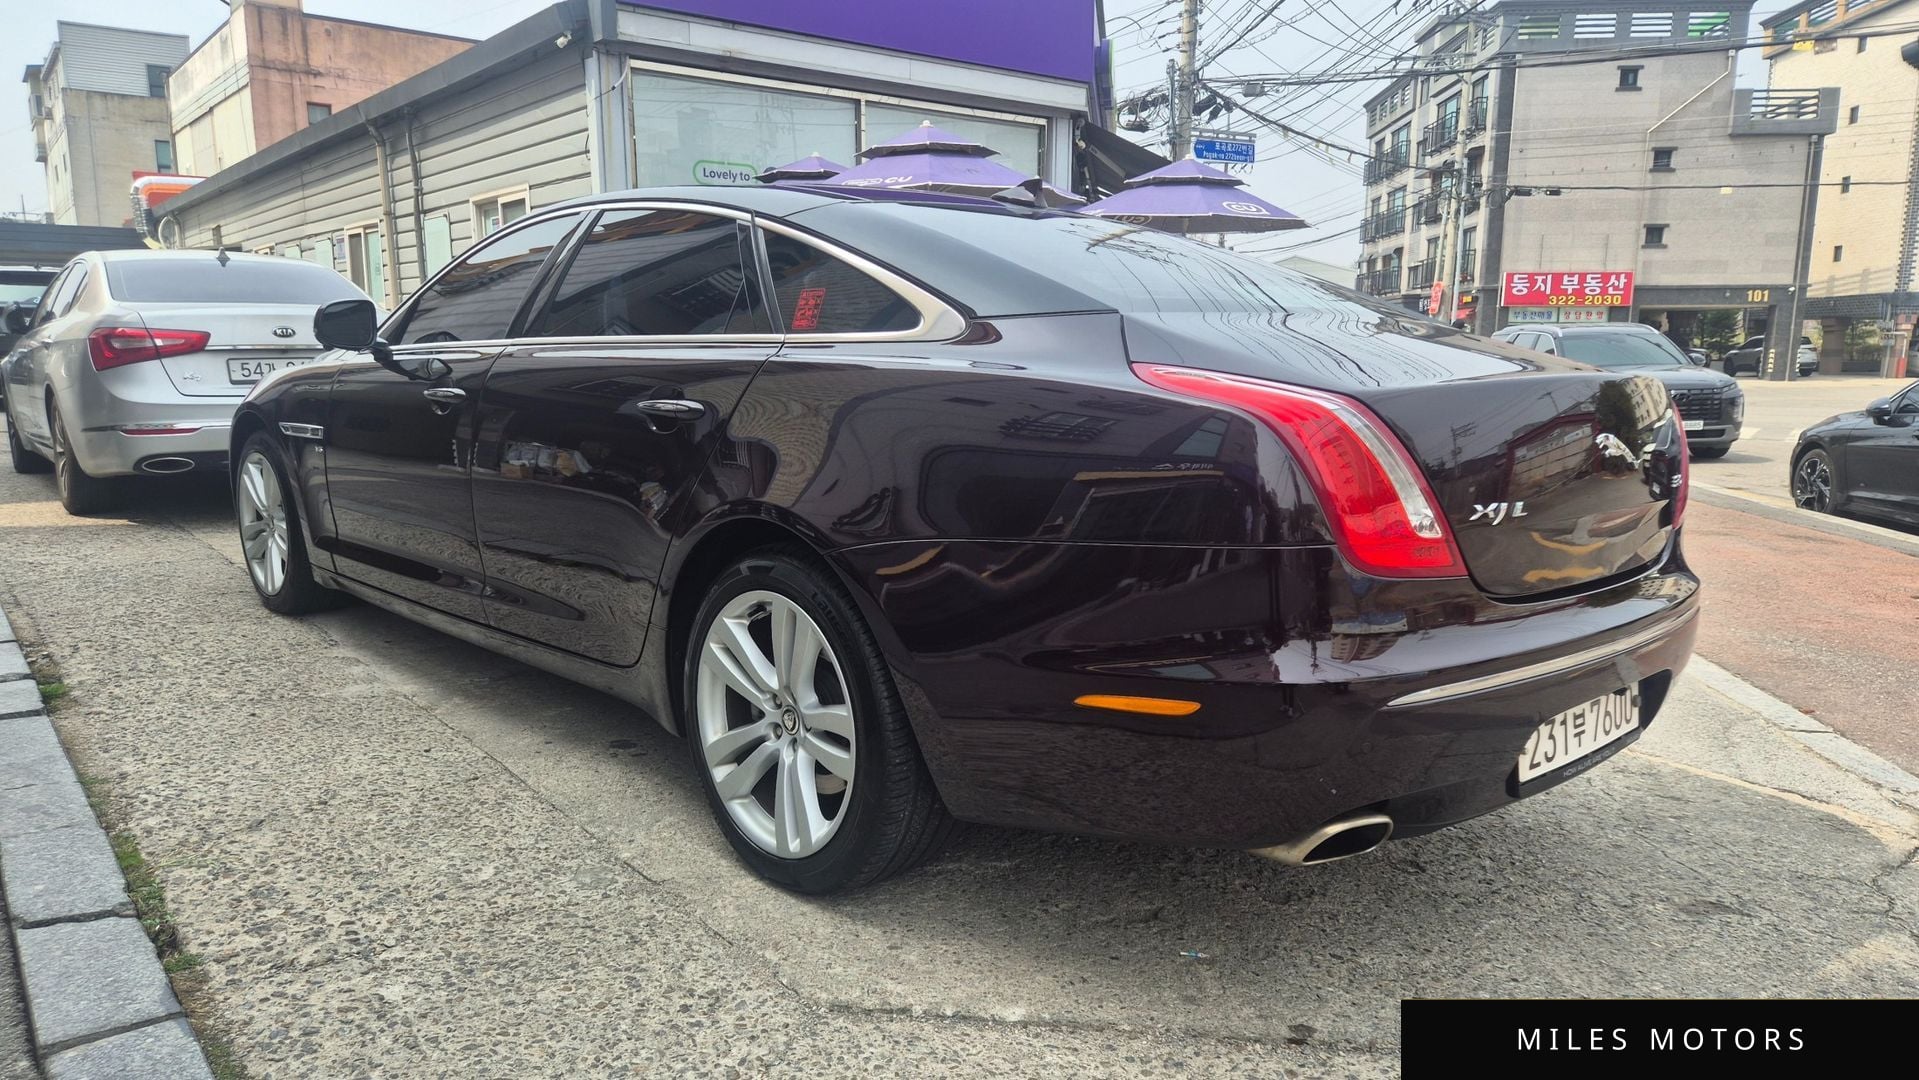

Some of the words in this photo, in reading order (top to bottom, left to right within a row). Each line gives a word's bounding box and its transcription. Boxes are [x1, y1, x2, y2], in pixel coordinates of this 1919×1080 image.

[703, 167, 738, 183] Lovely
[740, 172, 751, 182] to
[885, 176, 912, 184] CU
[1510, 274, 1553, 295] 둥지
[1560, 273, 1628, 295] 부동산
[1548, 295, 1622, 305] 322-2030
[1747, 289, 1769, 302] 101
[1469, 501, 1529, 526] XJL
[1528, 684, 1633, 771] 231부7600
